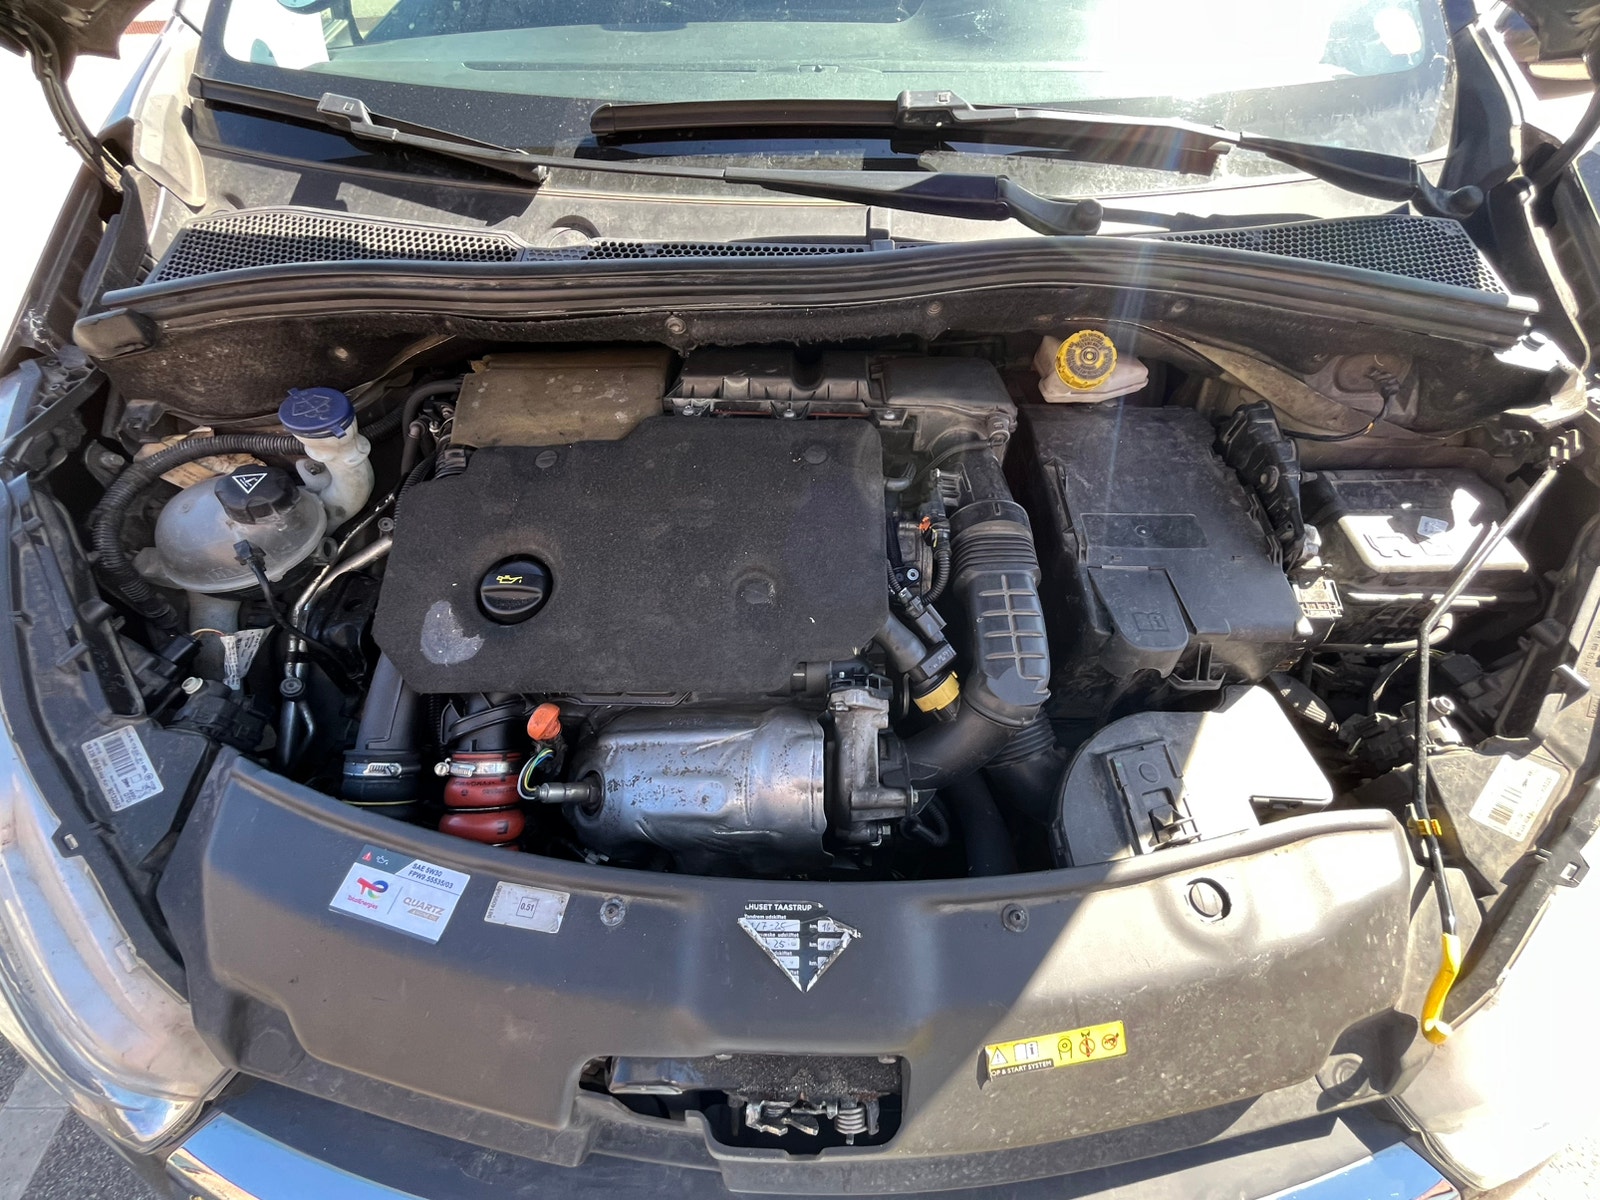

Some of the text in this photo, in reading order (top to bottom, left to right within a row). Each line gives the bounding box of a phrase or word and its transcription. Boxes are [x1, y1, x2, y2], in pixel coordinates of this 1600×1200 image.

[412, 863, 443, 878] SAE 5W30
[403, 896, 445, 916] QUARTZ
[520, 903, 535, 912] 0.51
[1007, 1064, 1027, 1074] START
[1028, 1060, 1052, 1071] SYSTEM
